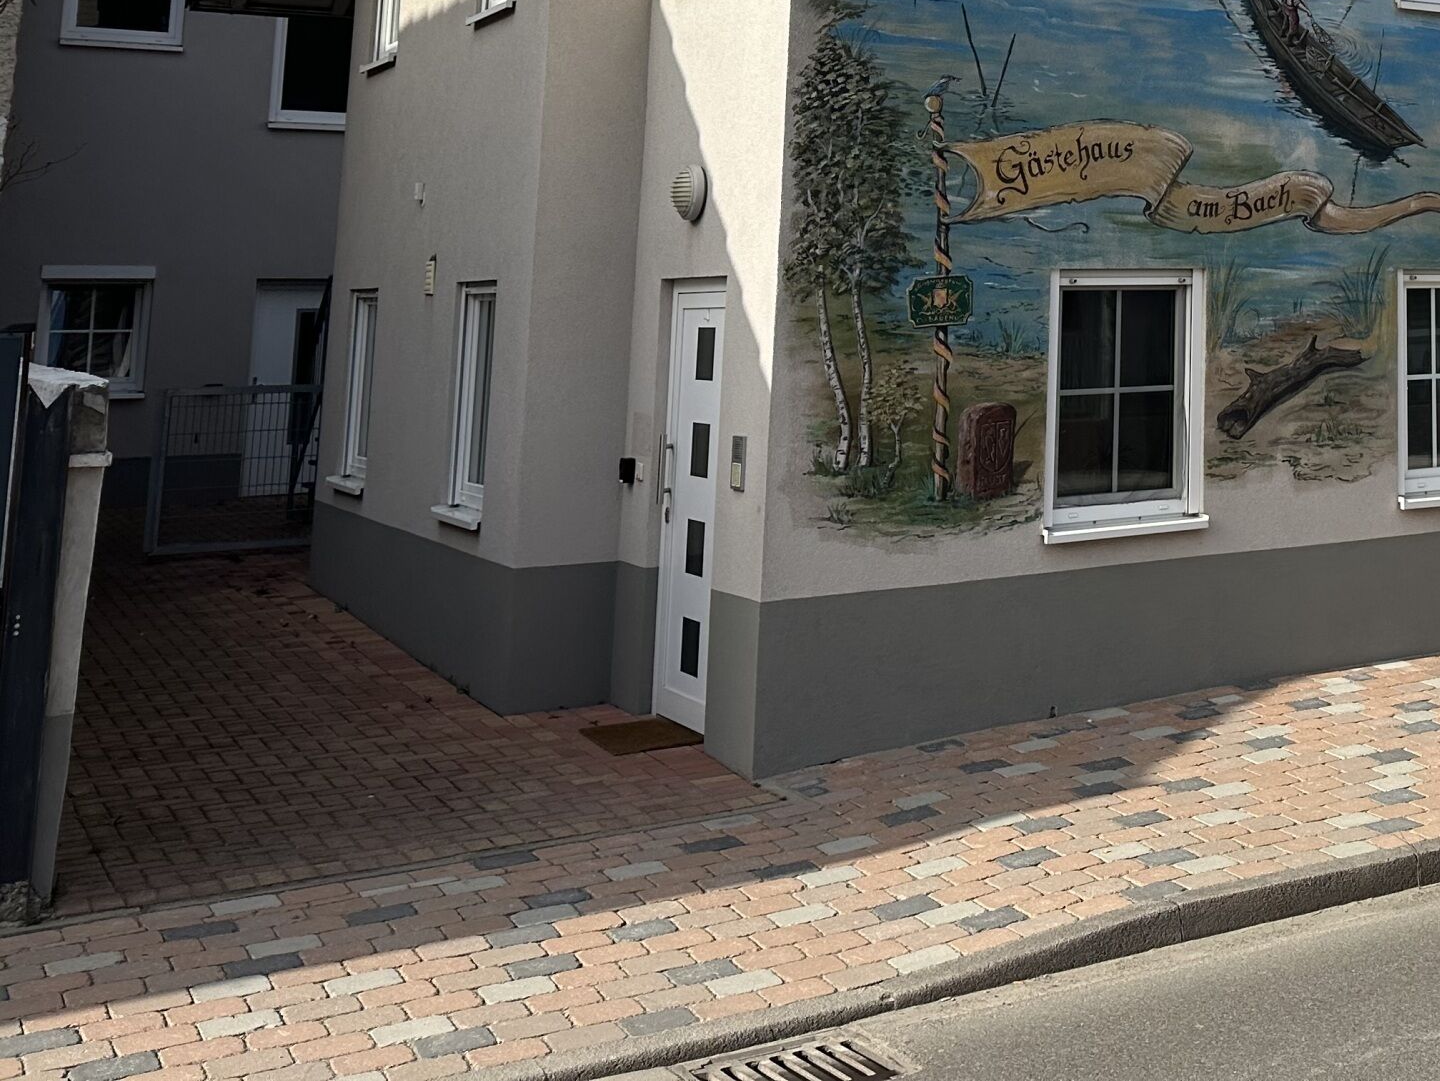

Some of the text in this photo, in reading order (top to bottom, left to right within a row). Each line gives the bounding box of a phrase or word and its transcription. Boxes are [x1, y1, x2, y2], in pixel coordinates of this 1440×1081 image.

[995, 127, 1295, 224] Gästehaus am Bach
